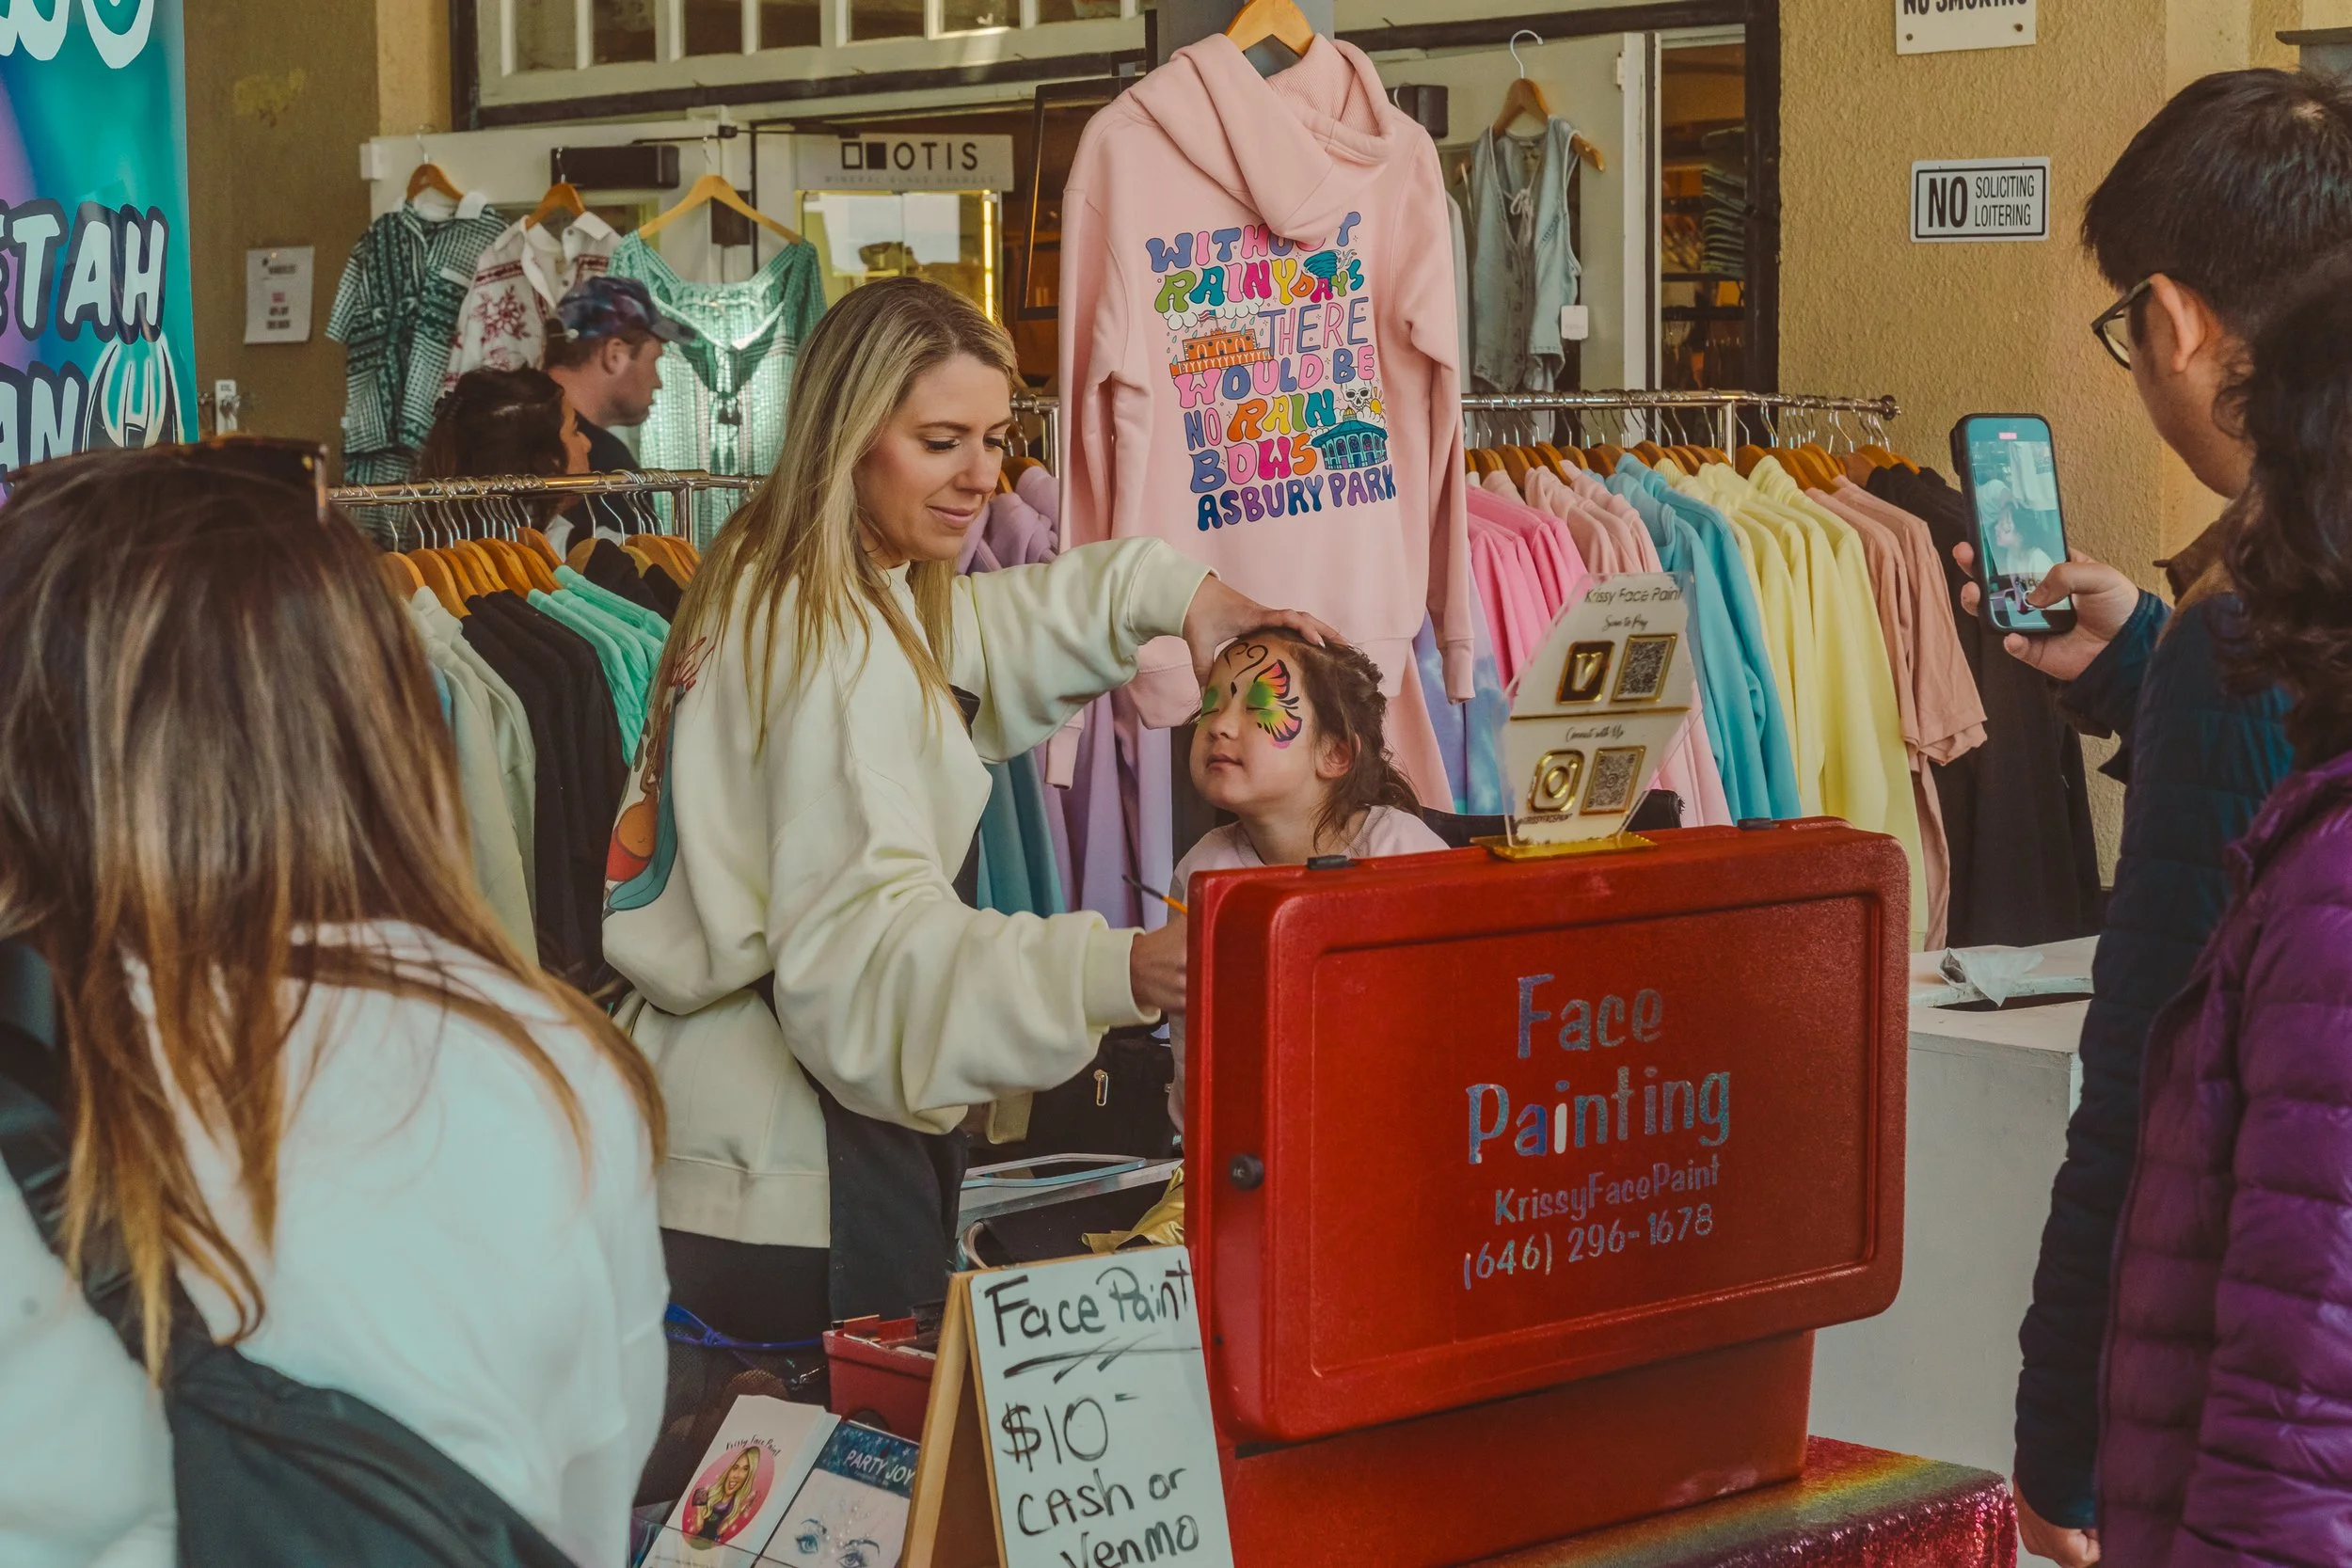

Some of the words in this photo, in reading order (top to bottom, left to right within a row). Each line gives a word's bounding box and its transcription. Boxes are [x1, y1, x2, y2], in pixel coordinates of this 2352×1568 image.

[894, 142, 978, 171] OTIS
[1976, 175, 2035, 198] SOLICITING
[1929, 176, 1968, 228] NO
[1975, 204, 2031, 227] LOITERING
[0, 201, 167, 339] TAH
[1146, 211, 1361, 273] WITHOT
[1154, 258, 1297, 313] RAINY
[1290, 259, 1364, 303] DAYS
[1258, 296, 1369, 356] THERE
[1173, 354, 1325, 408] WOULD
[1332, 344, 1375, 384] BE
[1184, 407, 1222, 451] NO
[1227, 388, 1337, 442] RAIN
[1189, 433, 1317, 494] BOWS
[1197, 474, 1324, 531] ASBURY
[1327, 464, 1397, 508] PARK
[1584, 589, 1616, 605] Krissy
[1619, 588, 1648, 603] Face
[1651, 587, 1683, 602] Paint
[1518, 974, 1662, 1059] Face
[1466, 1066, 1730, 1165] Painting
[1495, 1154, 1720, 1225] KrissyFacePaint
[1463, 1232, 1553, 1291] (646)
[1567, 1204, 1714, 1262] 296-1678
[984, 1275, 1106, 1347] Face
[1095, 1259, 1190, 1323] Paint
[844, 1449, 888, 1476] PARTY
[885, 1465, 915, 1485] JOY
[1149, 1467, 1187, 1500] or
